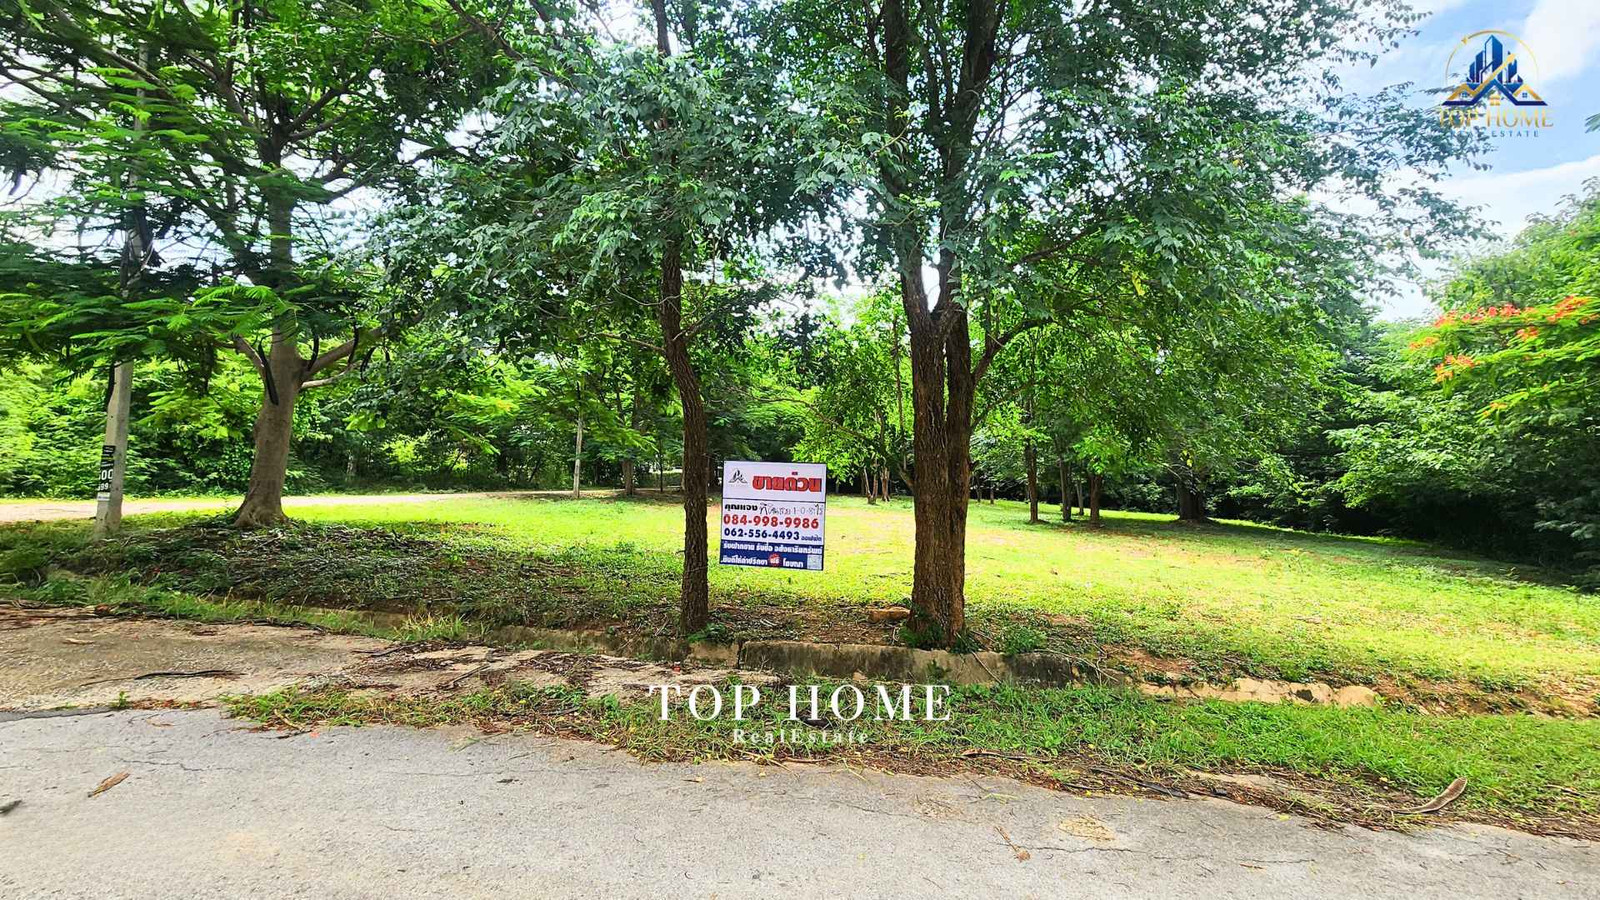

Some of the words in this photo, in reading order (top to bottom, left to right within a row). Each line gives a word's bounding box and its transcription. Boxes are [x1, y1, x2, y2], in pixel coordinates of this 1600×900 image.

[752, 471, 822, 493] ขายด่วน
[723, 514, 820, 530] 084-998-9986
[724, 528, 800, 541] 062-556-4493
